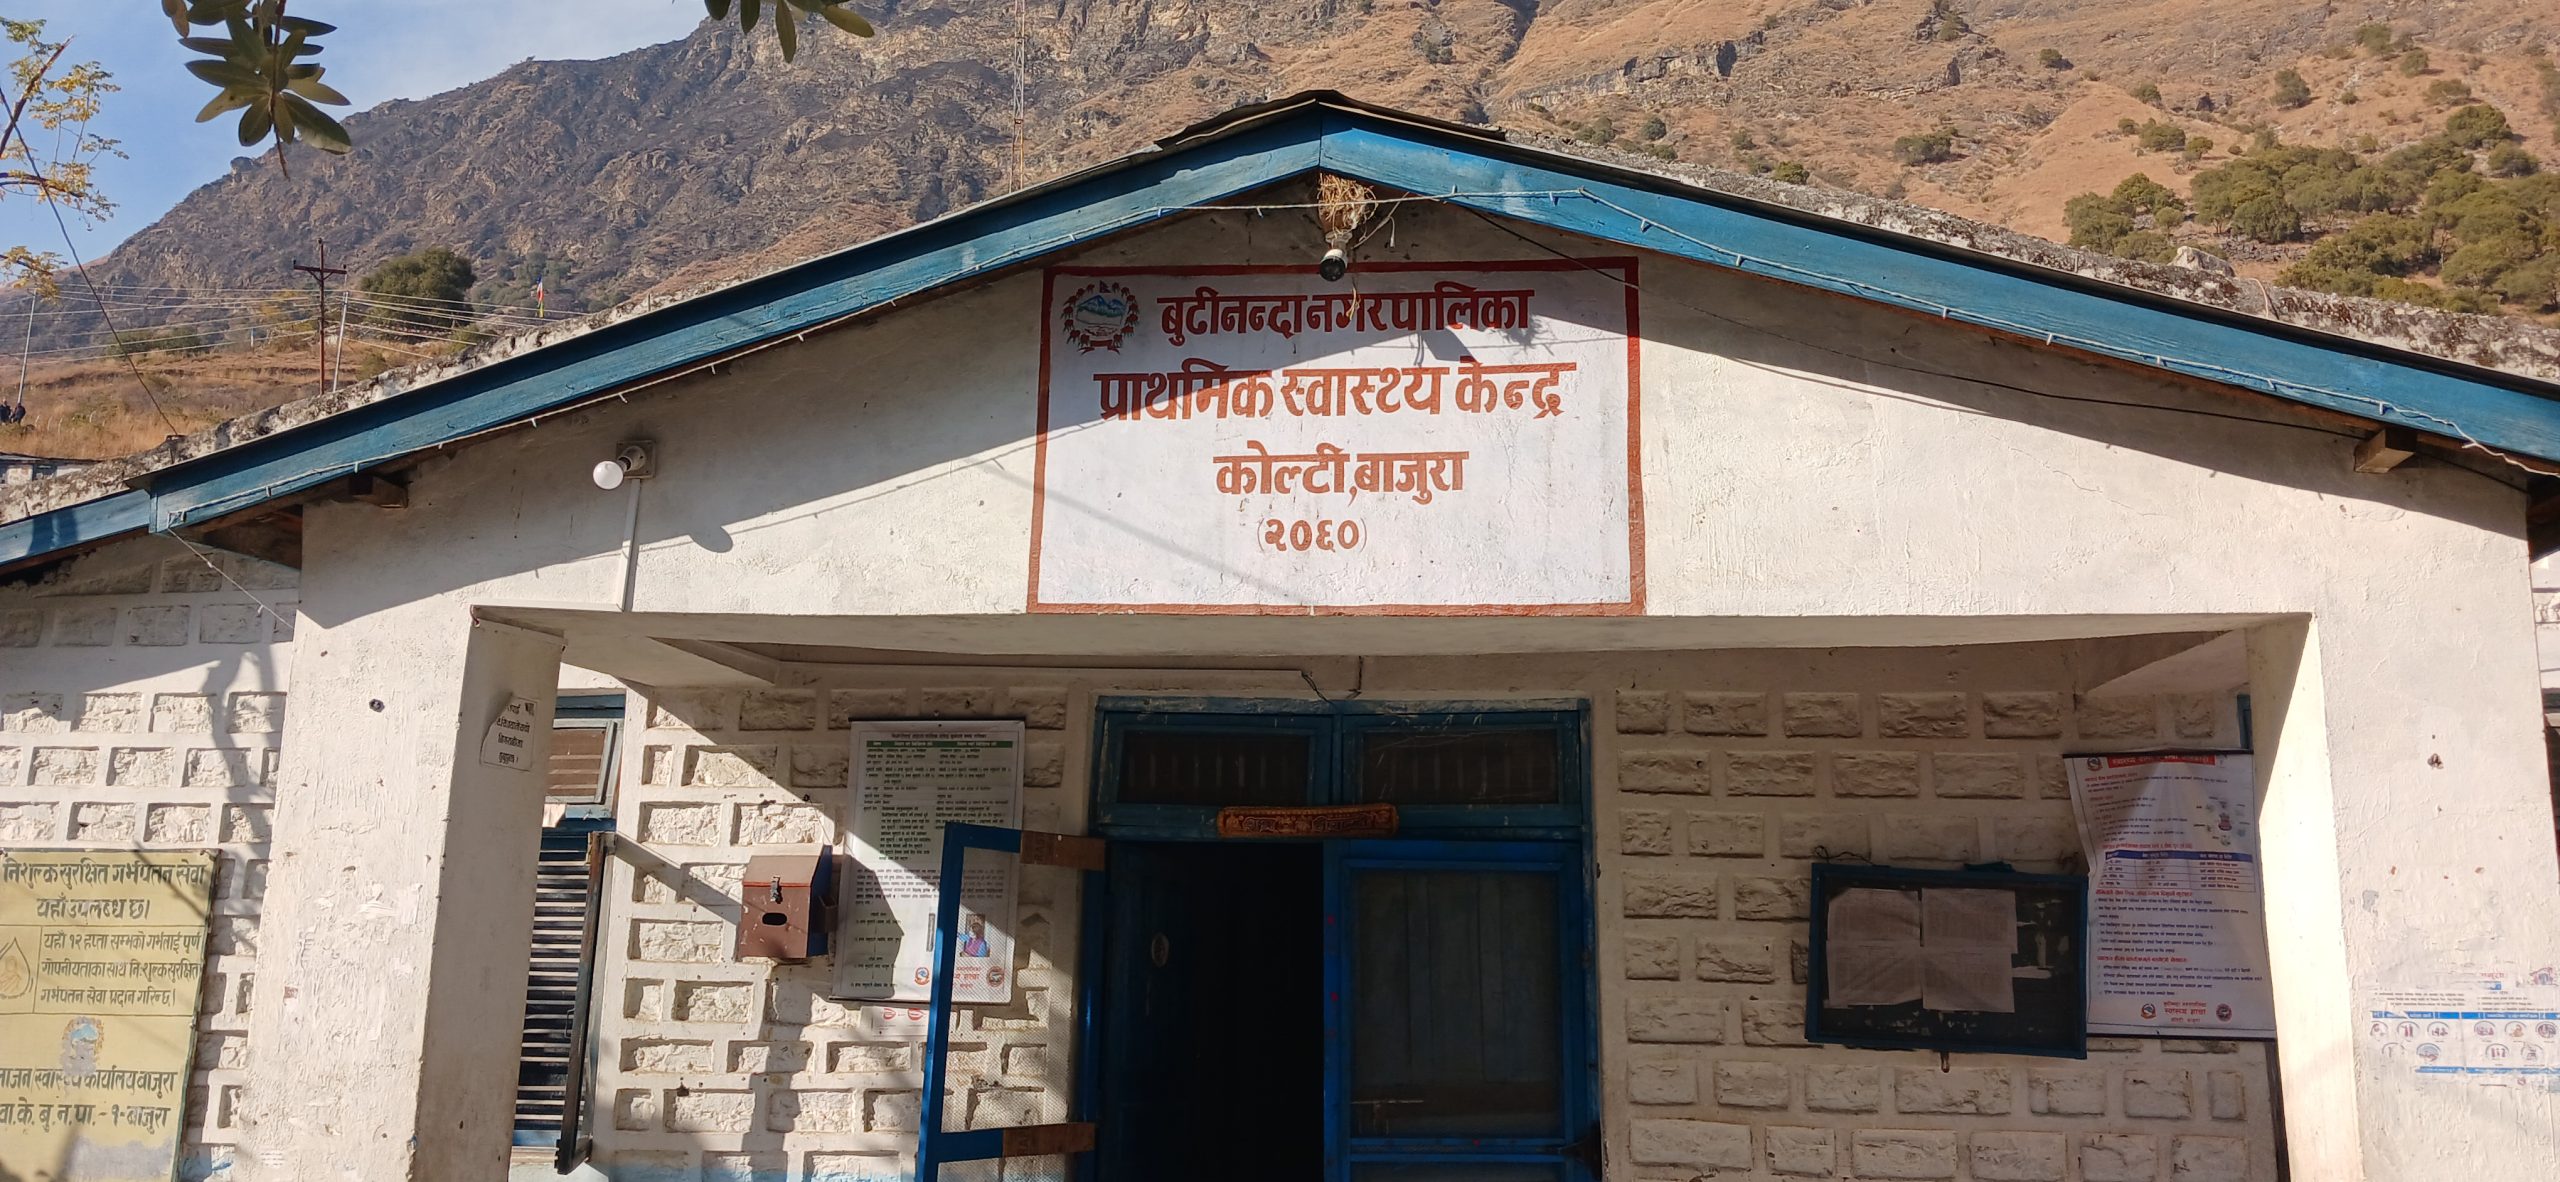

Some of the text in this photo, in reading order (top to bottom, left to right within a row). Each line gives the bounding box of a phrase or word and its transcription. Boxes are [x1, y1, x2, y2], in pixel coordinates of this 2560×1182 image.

[1307, 281, 1535, 332] नगरपालिका
[1093, 355, 1577, 420] प्राथमिक स्वास्थ्य केन्द्र
[1354, 451, 1470, 506] बाजुरा
[1257, 517, 1368, 553] (२०६०)
[60, 857, 110, 890] सुरक्षित
[112, 860, 176, 886] गर्भपतन
[176, 858, 206, 887] सेवा
[36, 892, 68, 921] यहाँ
[44, 930, 67, 950] यहाँ
[69, 934, 83, 950] १२
[86, 986, 108, 1006] सेवा
